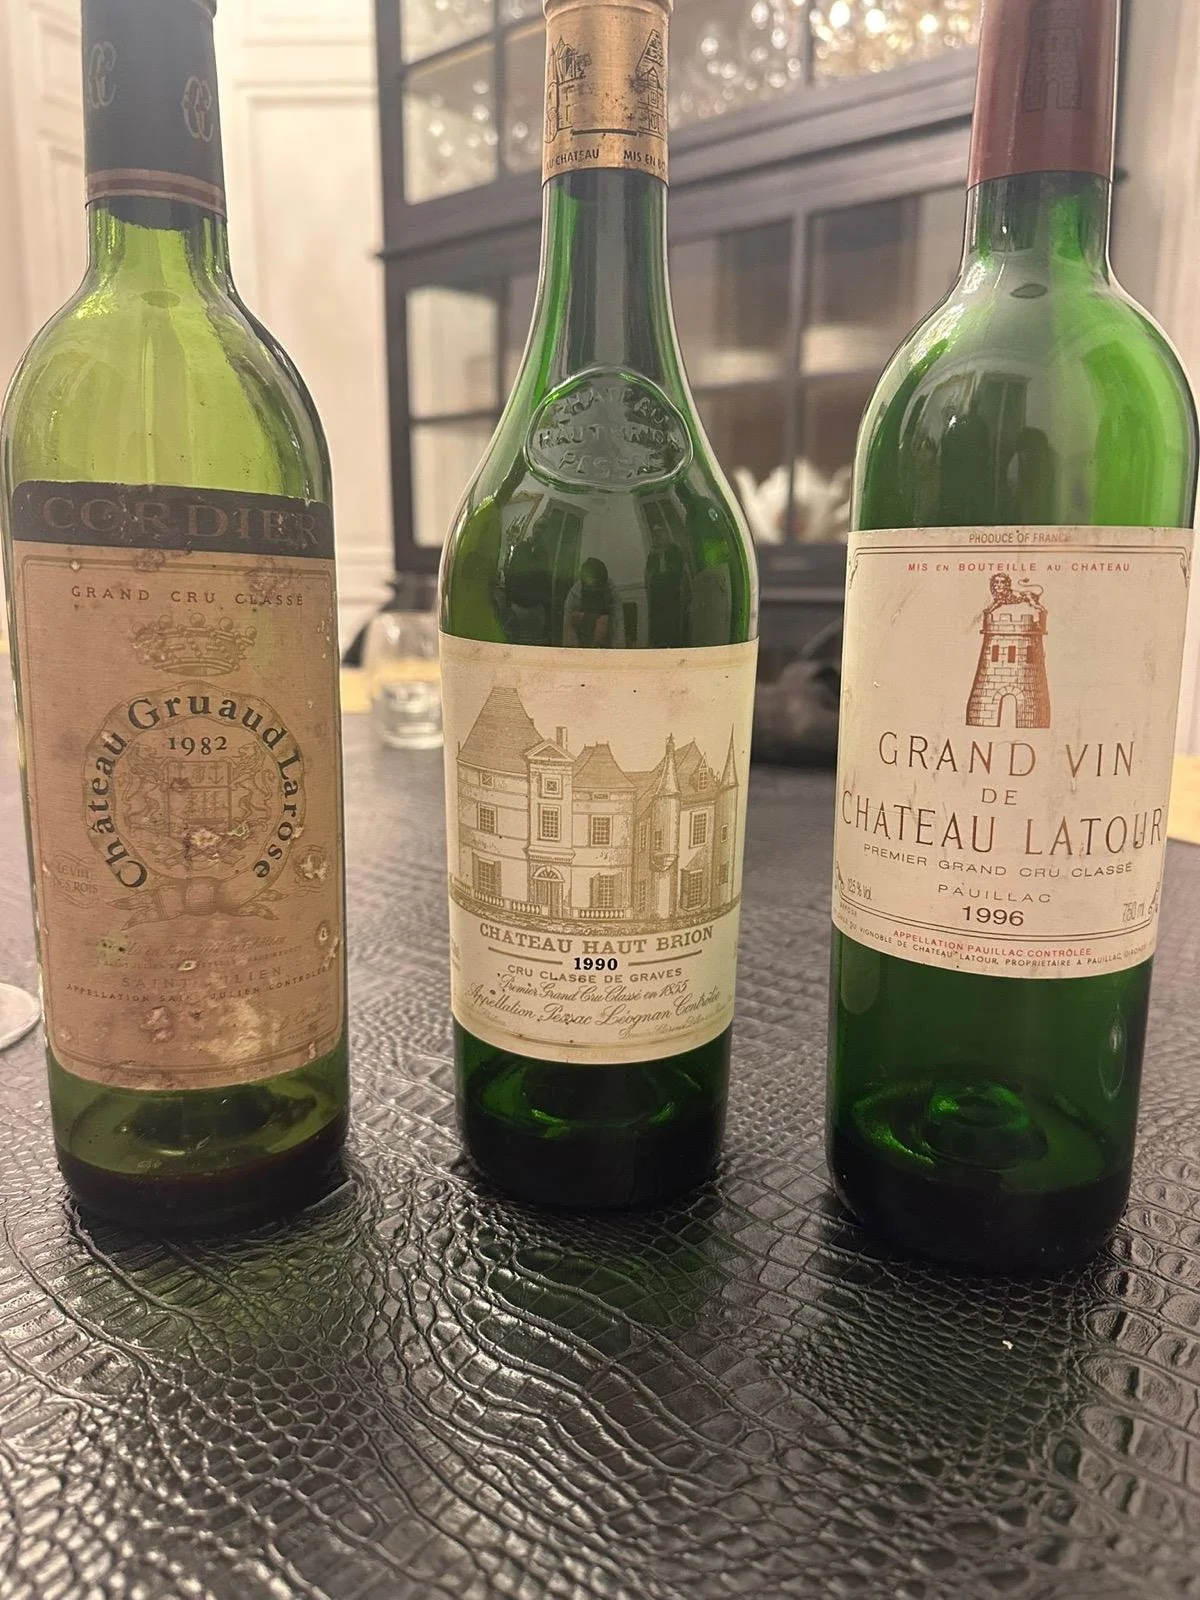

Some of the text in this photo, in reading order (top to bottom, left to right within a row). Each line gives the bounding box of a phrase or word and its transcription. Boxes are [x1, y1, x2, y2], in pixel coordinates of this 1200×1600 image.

[556, 149, 600, 166] CHATEAU
[623, 150, 642, 162] MIS
[645, 154, 656, 167] EN
[43, 495, 320, 546] CORDIER
[968, 532, 1014, 544] PRODUCE
[1016, 532, 1030, 543] OF
[908, 562, 928, 571] MIS
[958, 562, 1037, 572] BOUTEILLE
[1047, 564, 1061, 572] AU
[1071, 562, 1131, 572] CHATEAU
[71, 585, 150, 601] GRAND
[171, 590, 216, 604] CRU
[167, 735, 228, 756] 1982
[878, 731, 1136, 778] GRAND VIN
[88, 694, 301, 888] Château Gruaud Larose
[981, 787, 1018, 806] DE
[842, 790, 1163, 856] CHATEAU LATOUR
[863, 843, 928, 867] PREMIER
[938, 860, 1007, 876] GRAND
[1019, 867, 1060, 878] CRU
[937, 884, 1052, 903] PAUILLAC
[962, 905, 1024, 927] 1996
[480, 922, 714, 955] CHATEAU HAUT BRION
[860, 926, 893, 945] VIGNOBLE
[897, 939, 908, 948] DE
[912, 944, 954, 958] CHATEAU
[893, 930, 963, 951] APPELLATION
[967, 944, 1025, 957] PAUILLAC
[507, 964, 533, 977] CRU
[604, 974, 623, 984] DE
[629, 967, 683, 983] GRAVES
[573, 956, 618, 971] 1990
[65, 984, 150, 1003] APPELLATION
[538, 981, 579, 1002] Grand
[578, 983, 604, 1003] Cru
[643, 991, 658, 999] en
[658, 978, 690, 1000] 1855
[465, 982, 537, 1020] Appellation
[594, 1003, 672, 1031] Léognan
